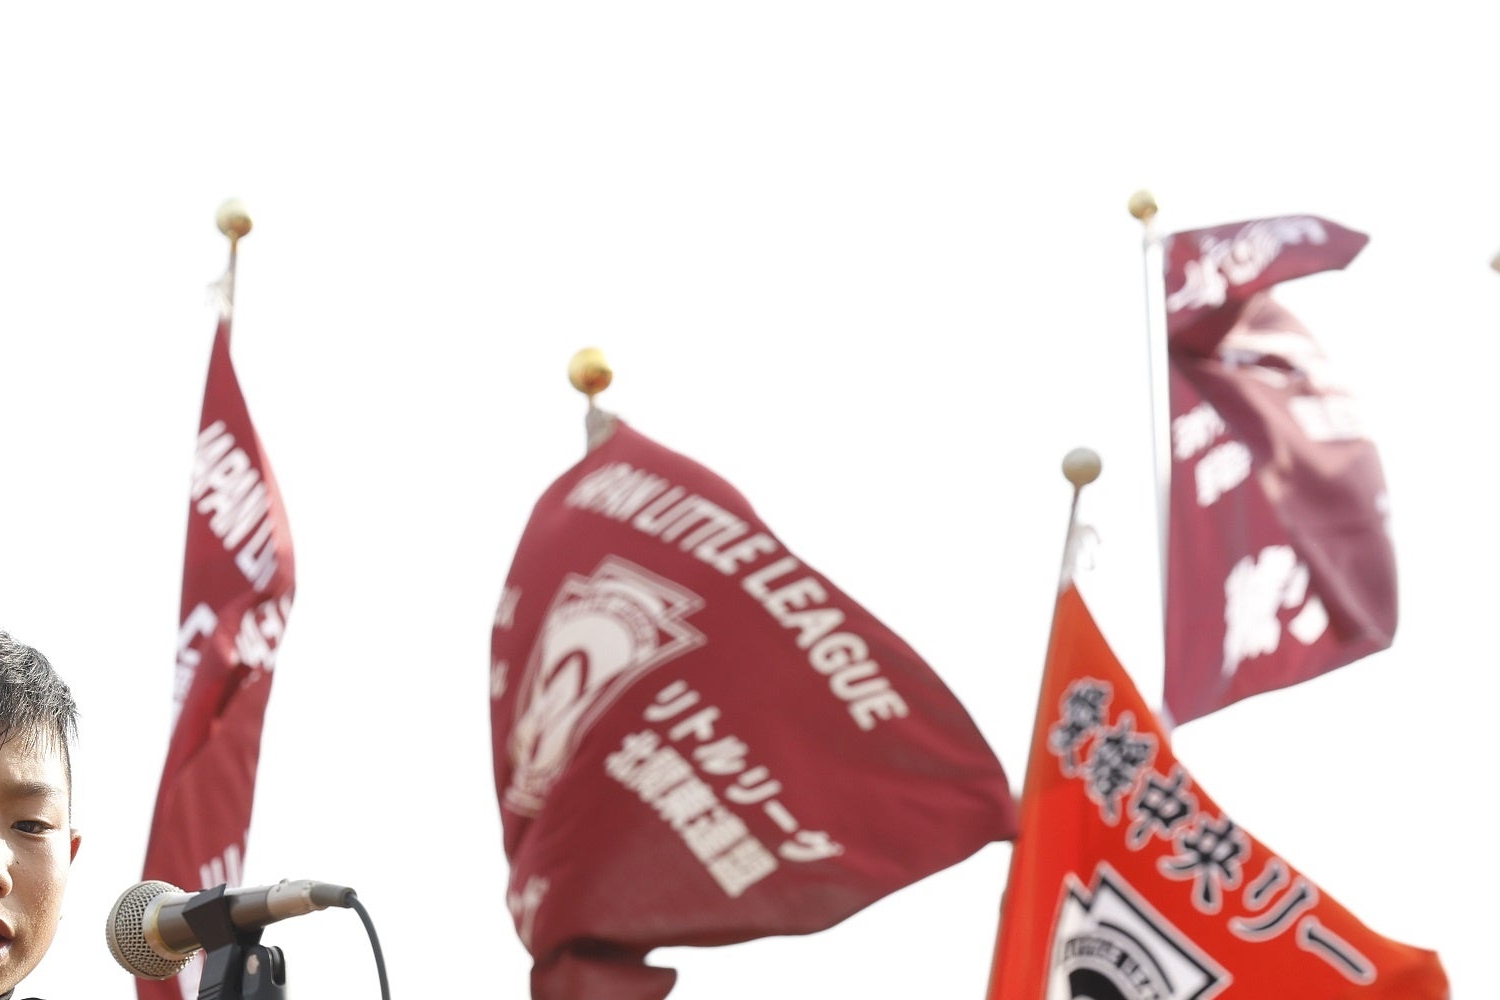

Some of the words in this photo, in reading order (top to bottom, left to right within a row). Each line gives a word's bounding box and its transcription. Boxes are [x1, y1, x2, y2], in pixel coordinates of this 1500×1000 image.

[631, 485, 779, 576] LITTLE
[741, 557, 909, 732] LEAGUE
[642, 680, 845, 862] リトルリーグ
